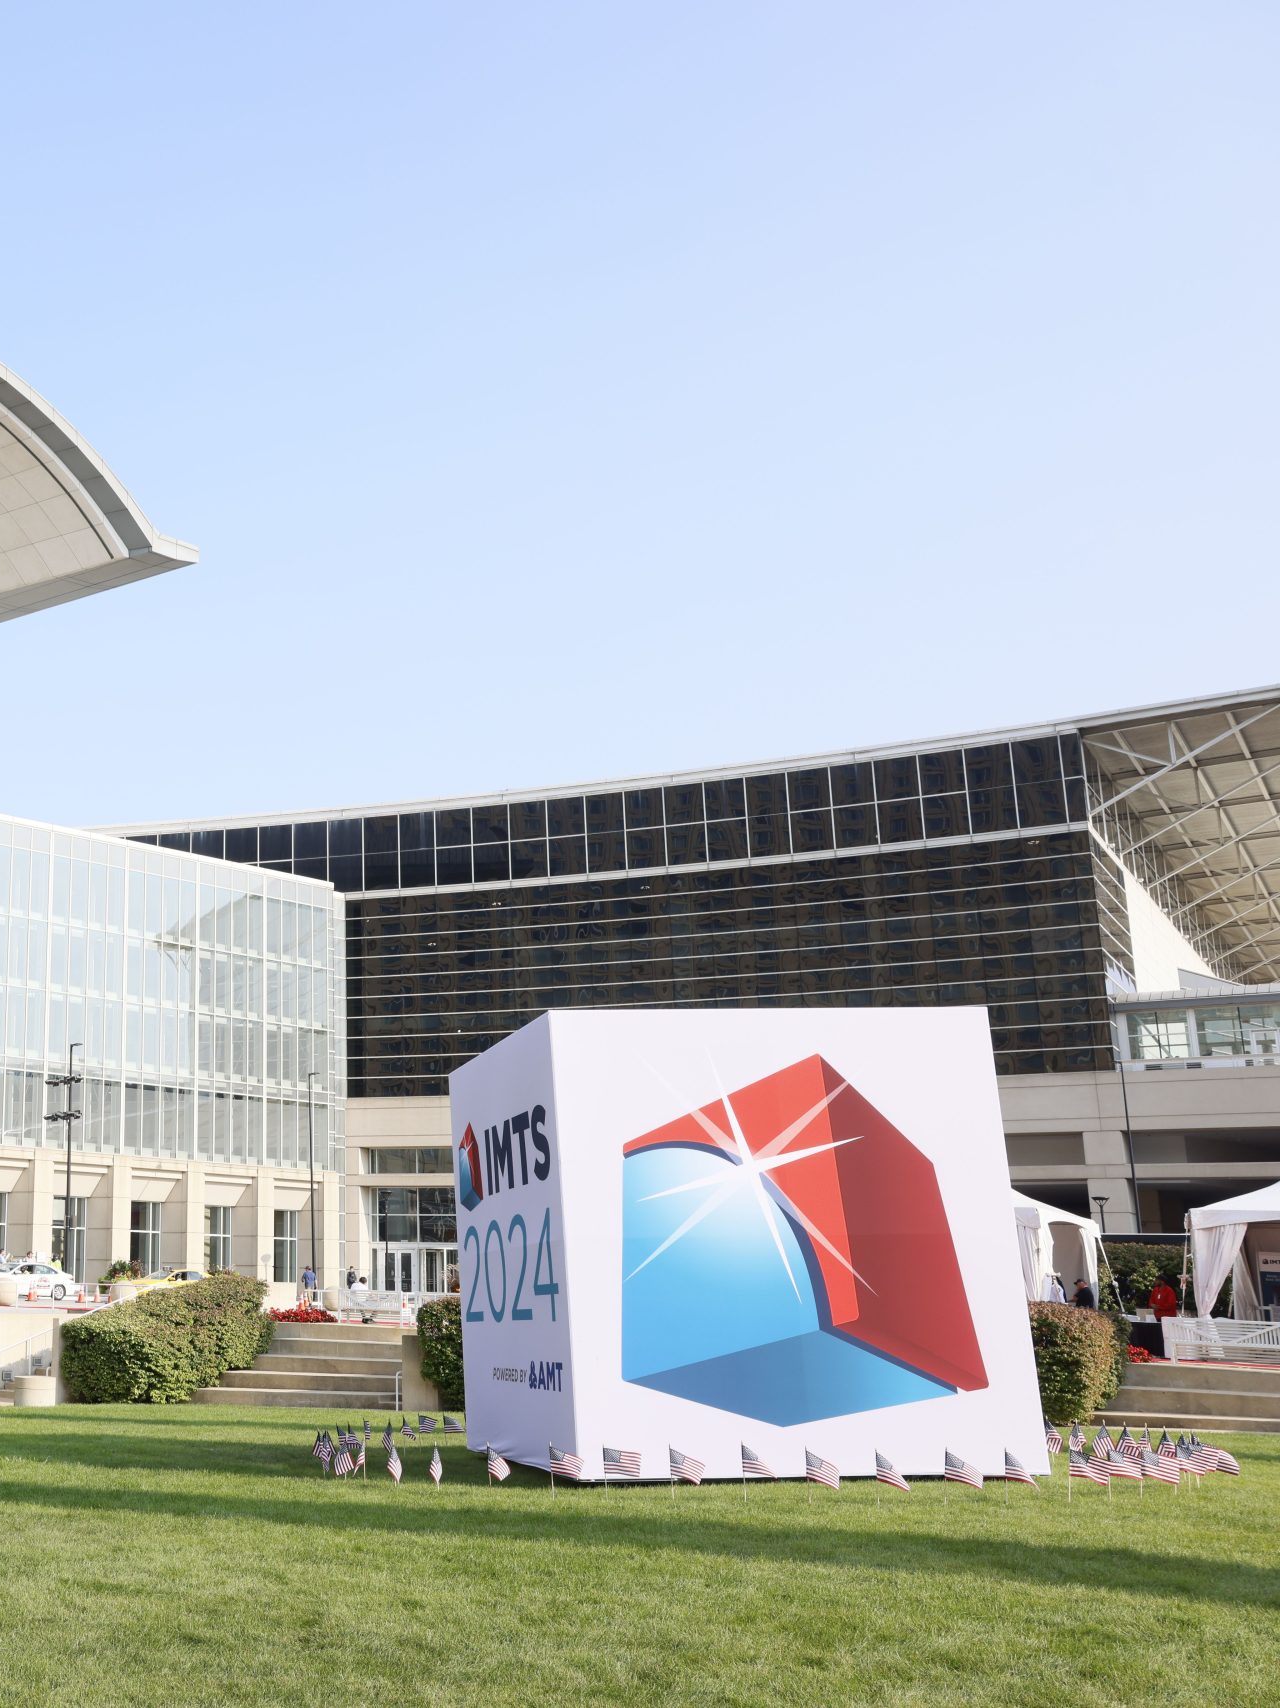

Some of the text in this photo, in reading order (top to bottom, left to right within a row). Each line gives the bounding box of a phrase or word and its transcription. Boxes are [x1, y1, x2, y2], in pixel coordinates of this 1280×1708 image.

[484, 1104, 550, 1196] IMTS
[463, 1207, 559, 1323] 2024
[493, 1361, 563, 1392] POWERED BY AMT
